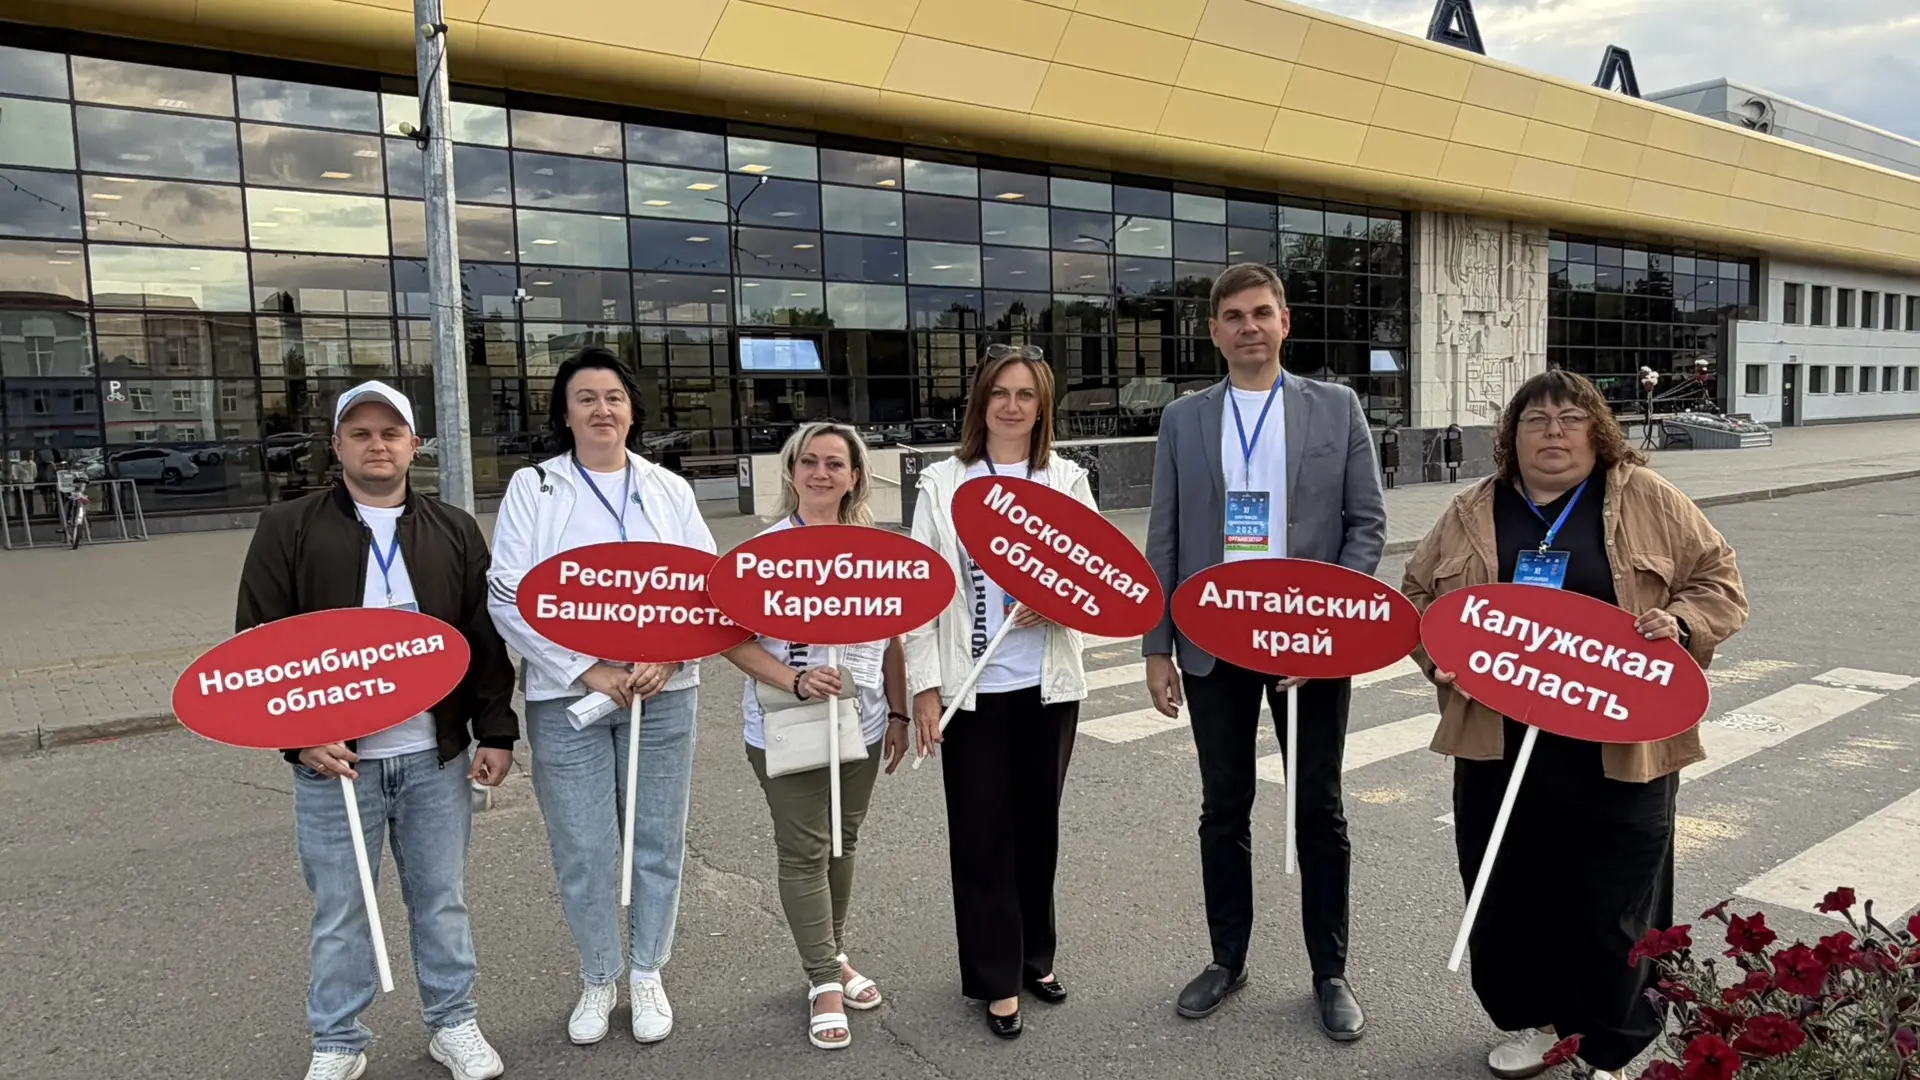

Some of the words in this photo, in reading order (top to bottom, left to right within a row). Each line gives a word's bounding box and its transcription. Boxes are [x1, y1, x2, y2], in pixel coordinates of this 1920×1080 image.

[109, 380, 121, 394] P
[983, 483, 1150, 604] Московская
[559, 560, 706, 595] Республи
[736, 552, 930, 586] Республика
[989, 536, 1100, 616] область
[536, 593, 735, 628] Башкортоста
[764, 589, 903, 623] Карелия
[1198, 581, 1391, 622] Алтайский
[1252, 627, 1333, 657] край
[1459, 594, 1675, 687] Калужская
[198, 634, 445, 696] Новосибирская
[266, 677, 396, 716] область
[1468, 650, 1629, 721] область
